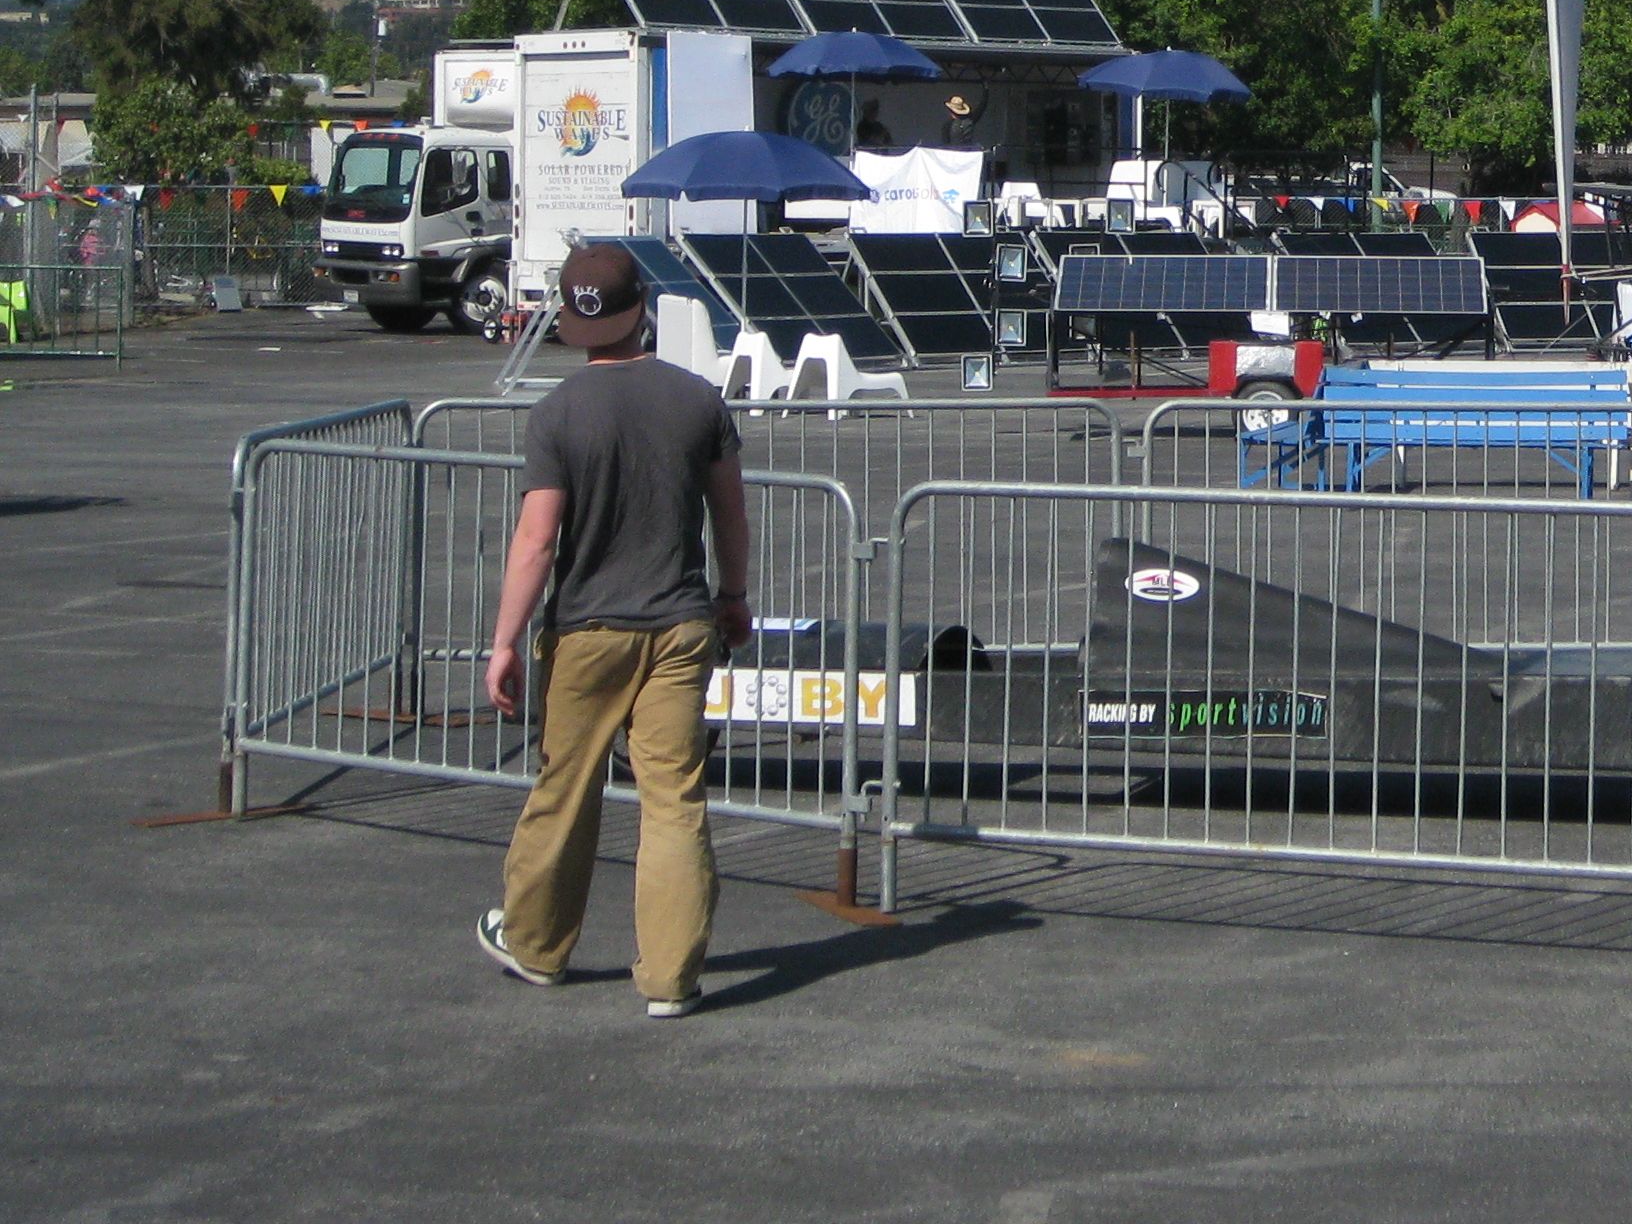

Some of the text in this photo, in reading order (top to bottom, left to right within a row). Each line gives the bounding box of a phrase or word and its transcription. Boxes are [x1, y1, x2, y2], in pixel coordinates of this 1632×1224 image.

[537, 109, 627, 133] SUSTAINABLE
[538, 163, 623, 176] SOLAR POWERED
[704, 675, 888, 719] JOBY
[1139, 703, 1157, 723] BY
[1168, 693, 1323, 733] sportvision
